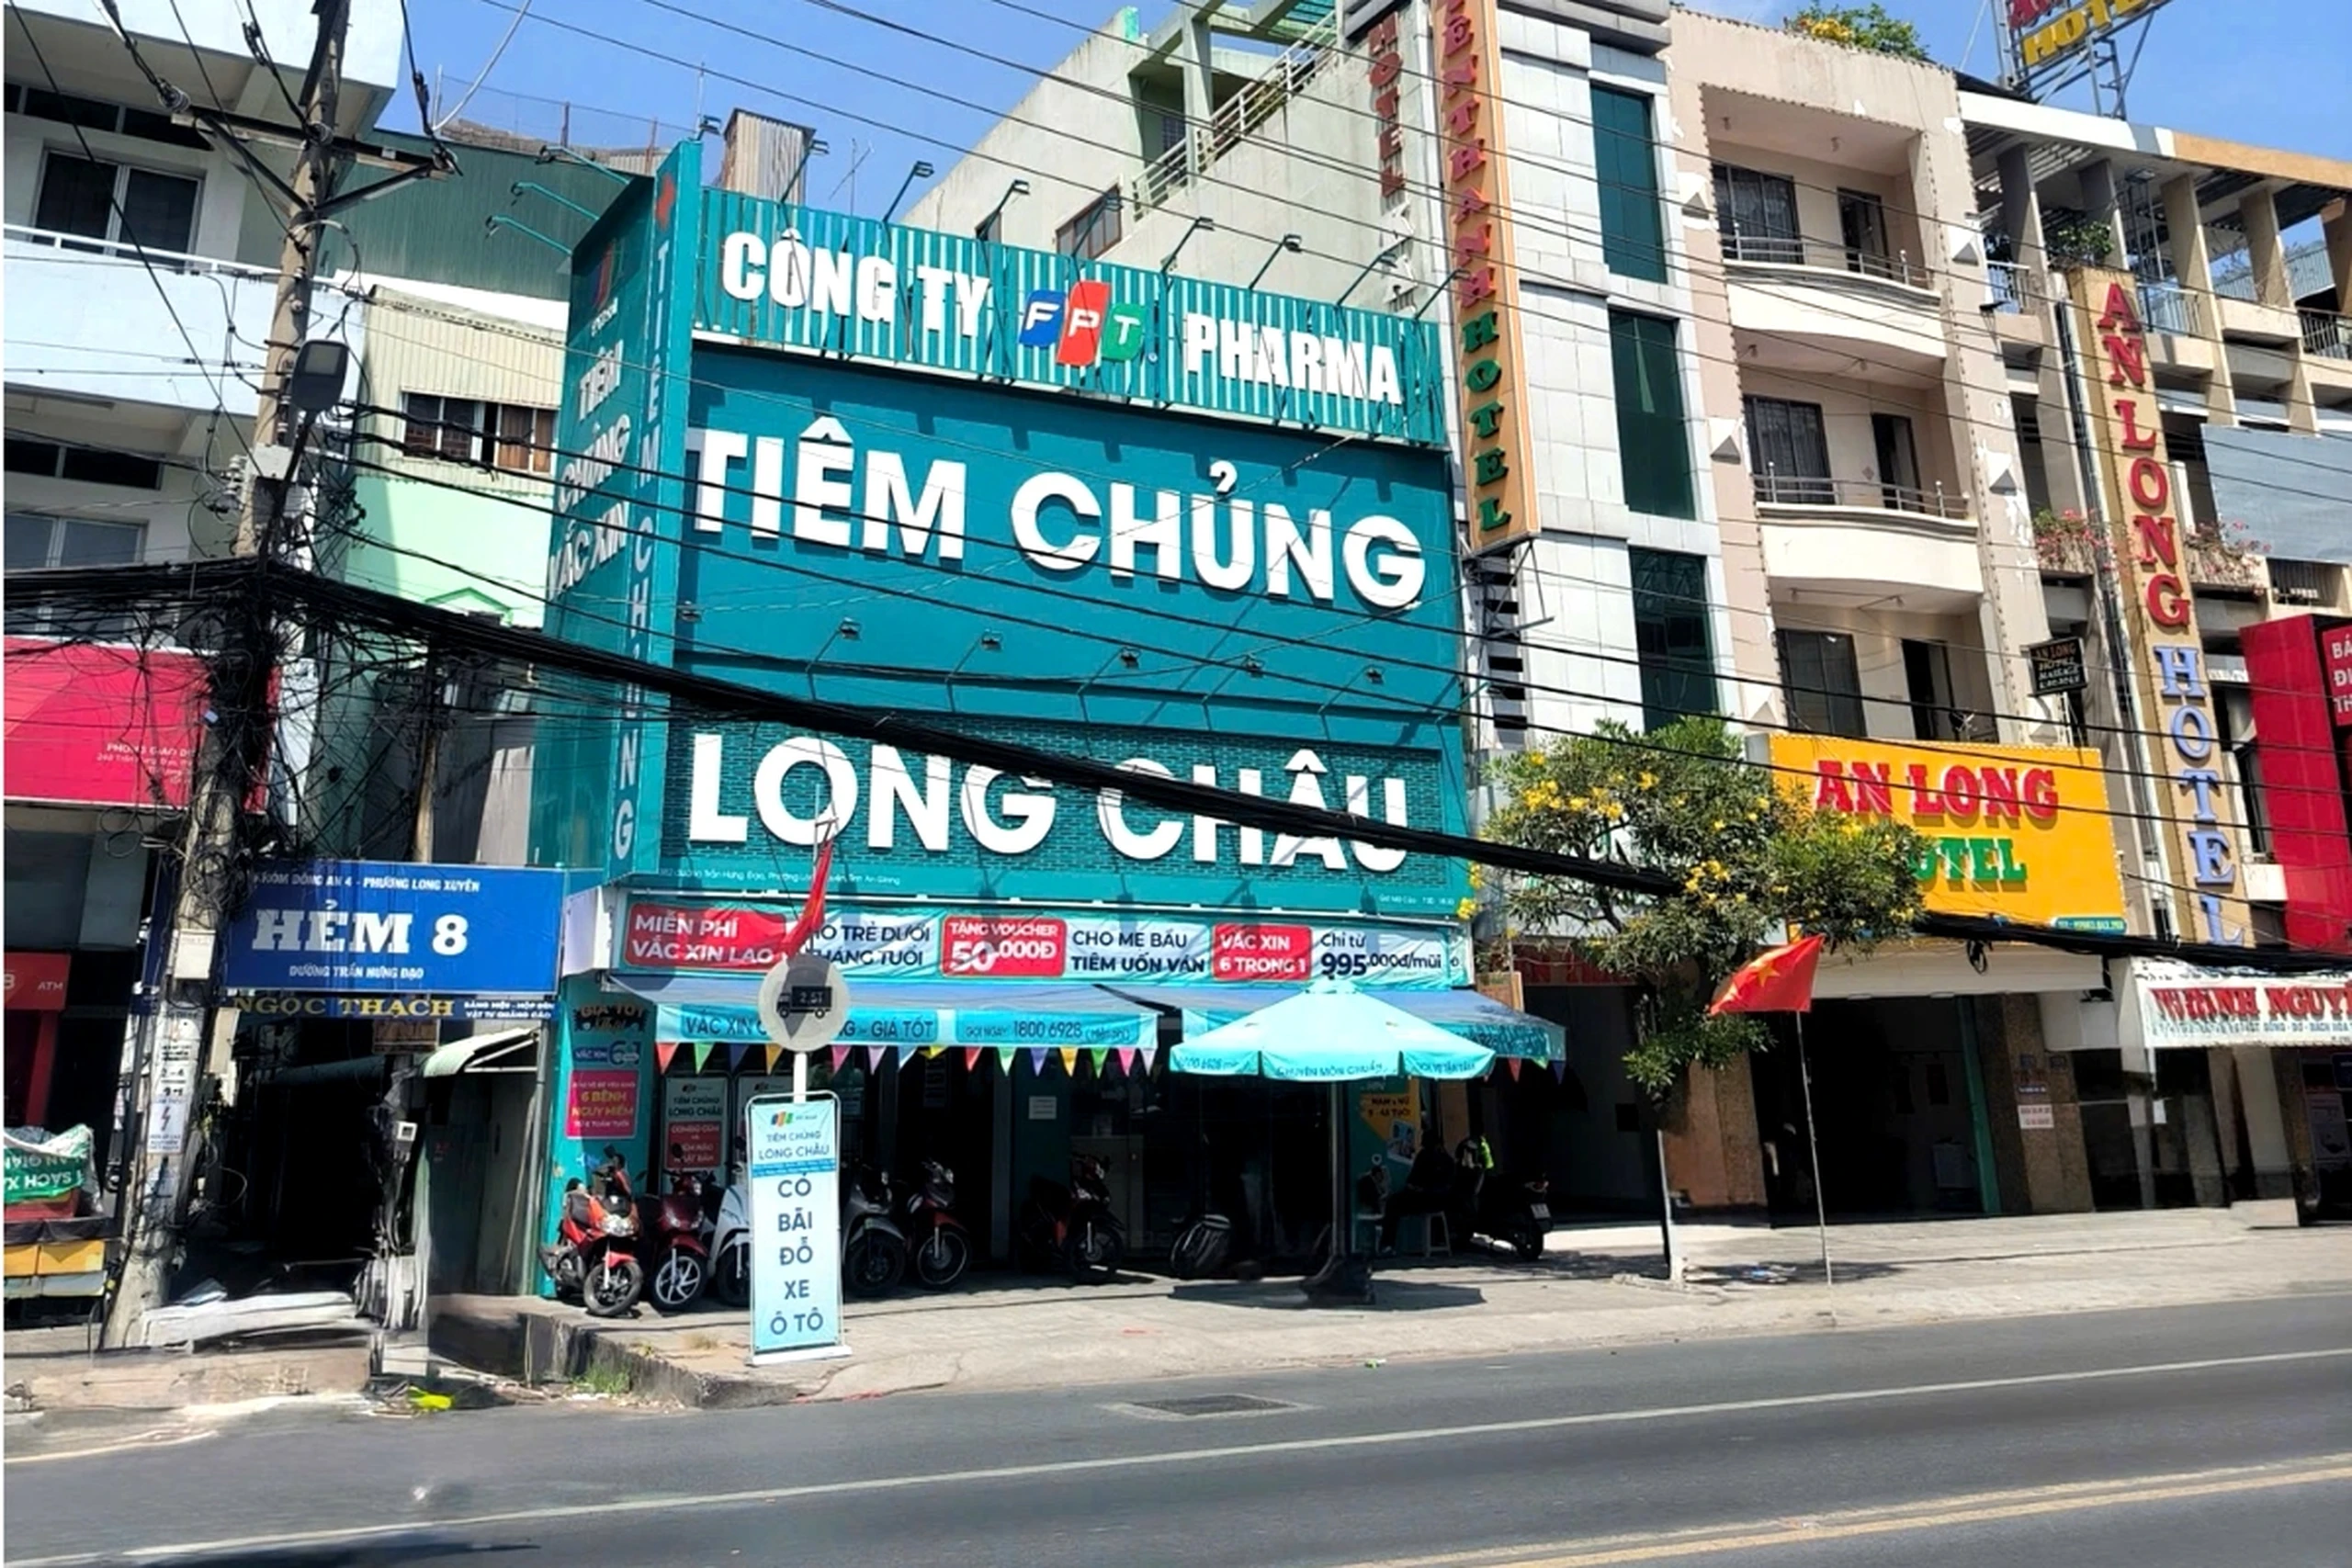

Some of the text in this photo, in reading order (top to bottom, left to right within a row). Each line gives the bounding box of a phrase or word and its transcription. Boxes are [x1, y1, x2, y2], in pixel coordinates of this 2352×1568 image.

[722, 229, 1403, 405] CÔNG TY FPT PHARMA
[1461, 310, 1511, 531] HOTEL
[690, 417, 1427, 609] TIÊM CHỦNG
[1815, 759, 2060, 820] AN LONG
[2154, 646, 2246, 949] HOTEL
[689, 734, 1408, 872] LONG CHÂU
[345, 875, 352, 887] 4
[412, 878, 441, 891] LONG
[443, 878, 481, 892] XUYÊN
[252, 899, 469, 955] HẺM 8
[635, 909, 740, 938] MIỄN PHÍ
[841, 920, 877, 942] TRẺ
[881, 921, 931, 942] DƯỚI
[990, 923, 1057, 937] VOUCHER
[632, 935, 774, 964] VẮC XIN LAO
[1072, 930, 1115, 948] CHO
[1118, 931, 1144, 951] MẸ
[1260, 934, 1290, 950] XIN
[1320, 931, 1366, 949] Chỉ từ
[1071, 950, 1205, 973] TIÊM UỐN VÁN
[1219, 957, 1306, 974] 6 TRONG 1
[38, 981, 63, 991] ATM
[338, 998, 454, 1019] THẠCH
[685, 1010, 721, 1035] VẮC
[727, 1017, 753, 1036] XIN
[871, 1017, 899, 1037] GIÁ
[902, 1015, 933, 1037] TỐT
[1013, 1021, 1045, 1038] 1800
[1048, 1021, 1083, 1038] 6928
[758, 1142, 830, 1160] LONG CHÂU
[777, 1172, 812, 1198] CÓ
[778, 1208, 813, 1232] BÃI
[778, 1237, 813, 1266] ĐỖ
[784, 1280, 810, 1300] XE
[770, 1306, 824, 1335] Ô TÔ
